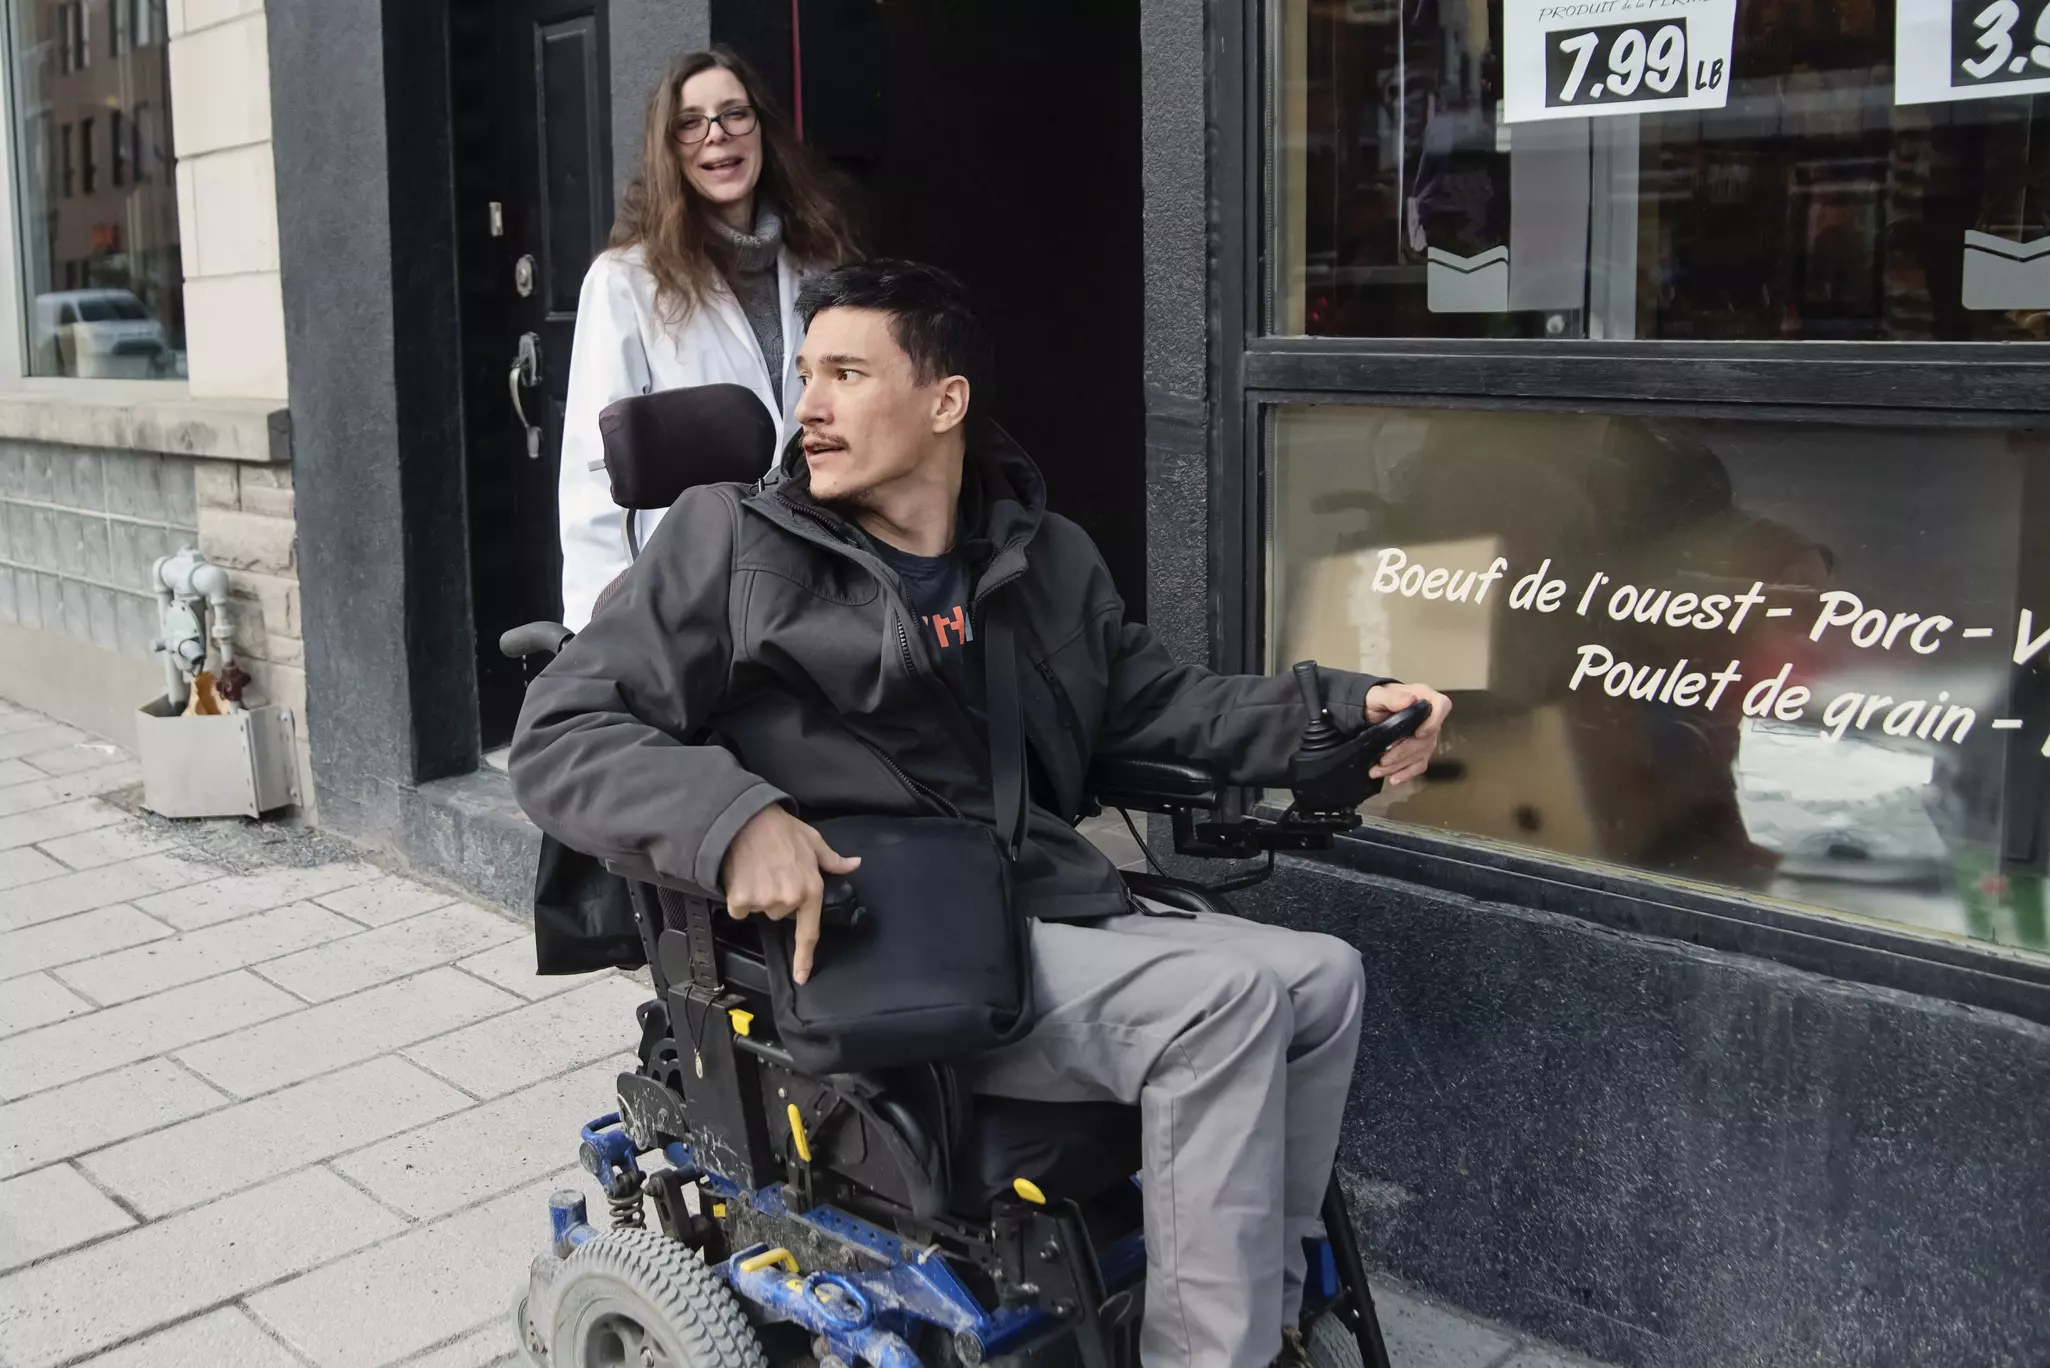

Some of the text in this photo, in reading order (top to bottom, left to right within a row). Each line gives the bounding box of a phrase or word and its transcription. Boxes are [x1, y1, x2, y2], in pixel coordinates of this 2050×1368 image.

[1538, 4, 1616, 22] PRODUIT
[1621, 1, 1632, 11] de
[1559, 25, 1724, 102] 7.99 LB
[1371, 548, 1507, 604] Boeuf
[1509, 559, 1566, 612] de
[1809, 591, 1952, 654] Porc
[1569, 644, 1742, 711] Poulet
[1742, 663, 1811, 721] de
[1822, 691, 1976, 744] grain
